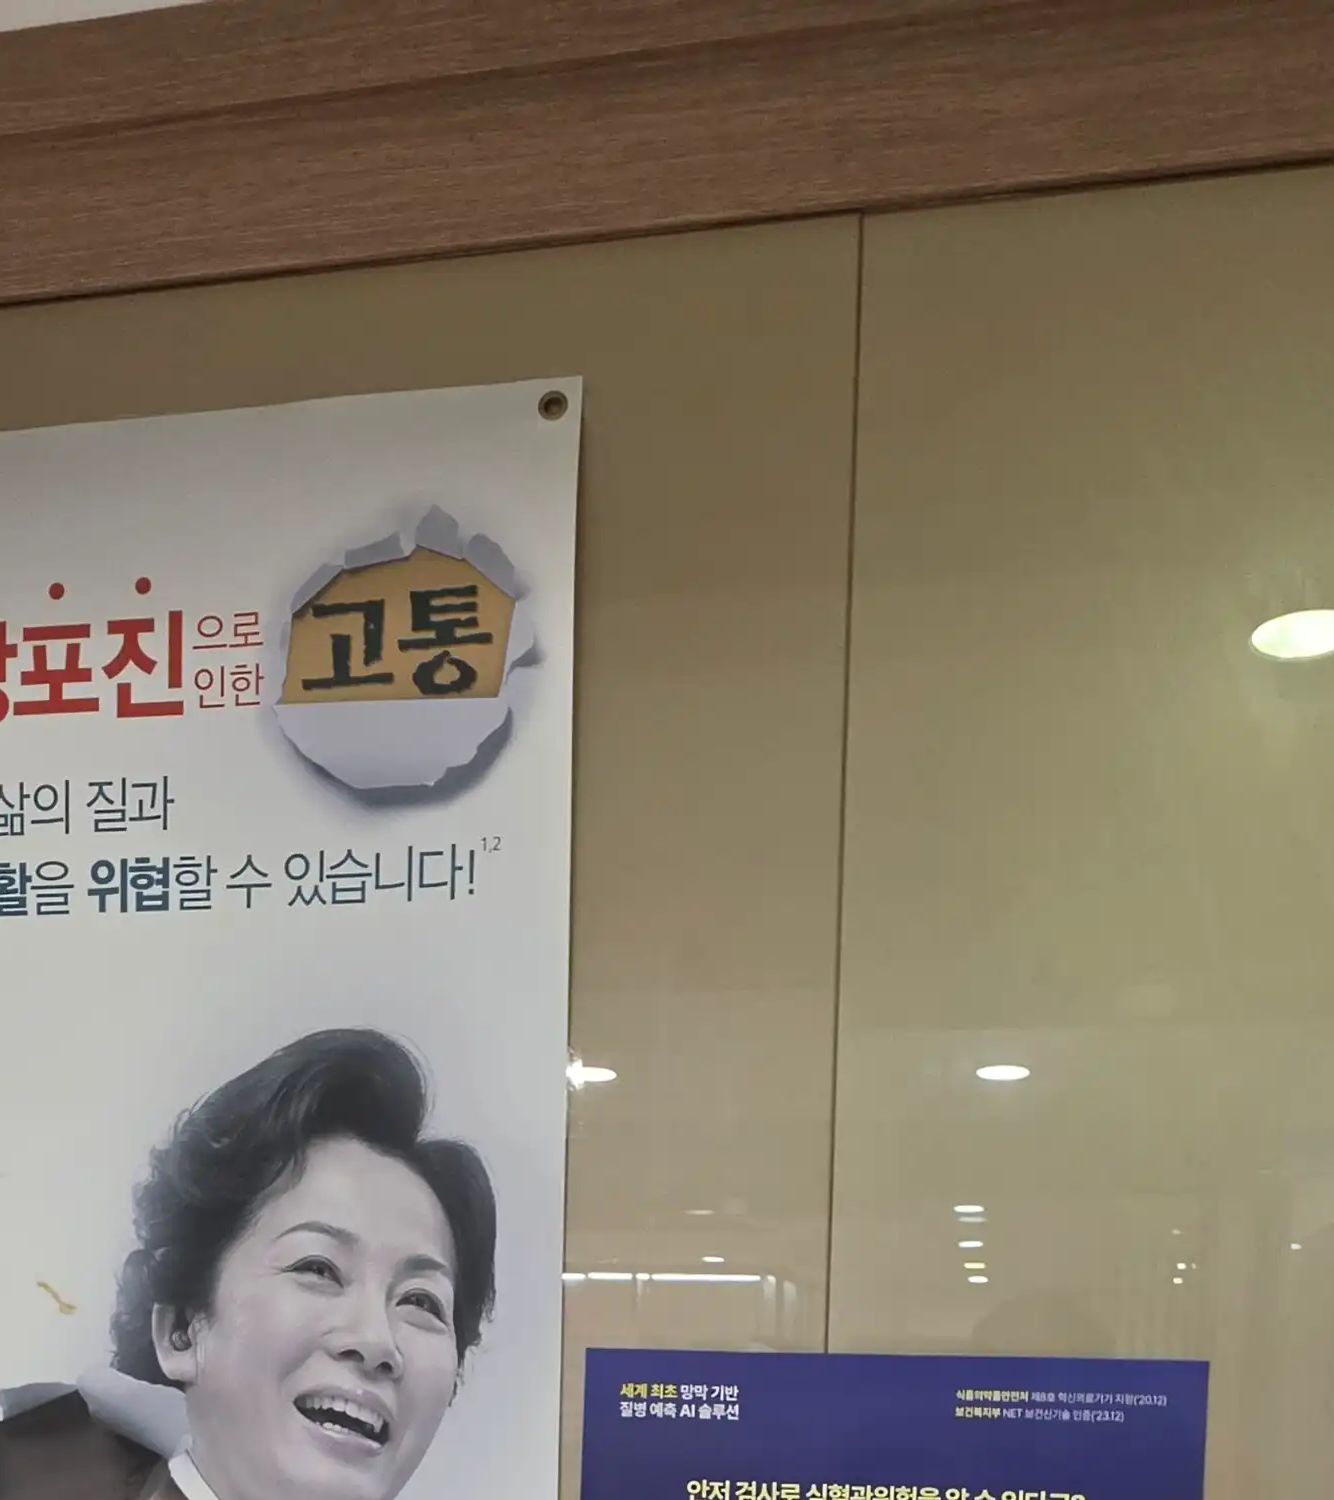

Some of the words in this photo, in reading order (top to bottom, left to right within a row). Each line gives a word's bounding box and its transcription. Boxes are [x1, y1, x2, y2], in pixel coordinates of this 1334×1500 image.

[302, 585, 493, 696] 고통
[194, 663, 264, 709] 인한
[86, 776, 175, 833] 질과
[88, 856, 217, 914] 위협할
[226, 855, 272, 907] 수
[619, 1383, 647, 1399] 세계
[650, 1383, 677, 1399] 최초
[680, 1384, 708, 1400] 망막
[711, 1385, 738, 1401] 기반
[619, 1401, 646, 1418] 질병
[650, 1402, 677, 1418] 예측
[680, 1404, 695, 1418] AI
[698, 1403, 740, 1420] 솔루션
